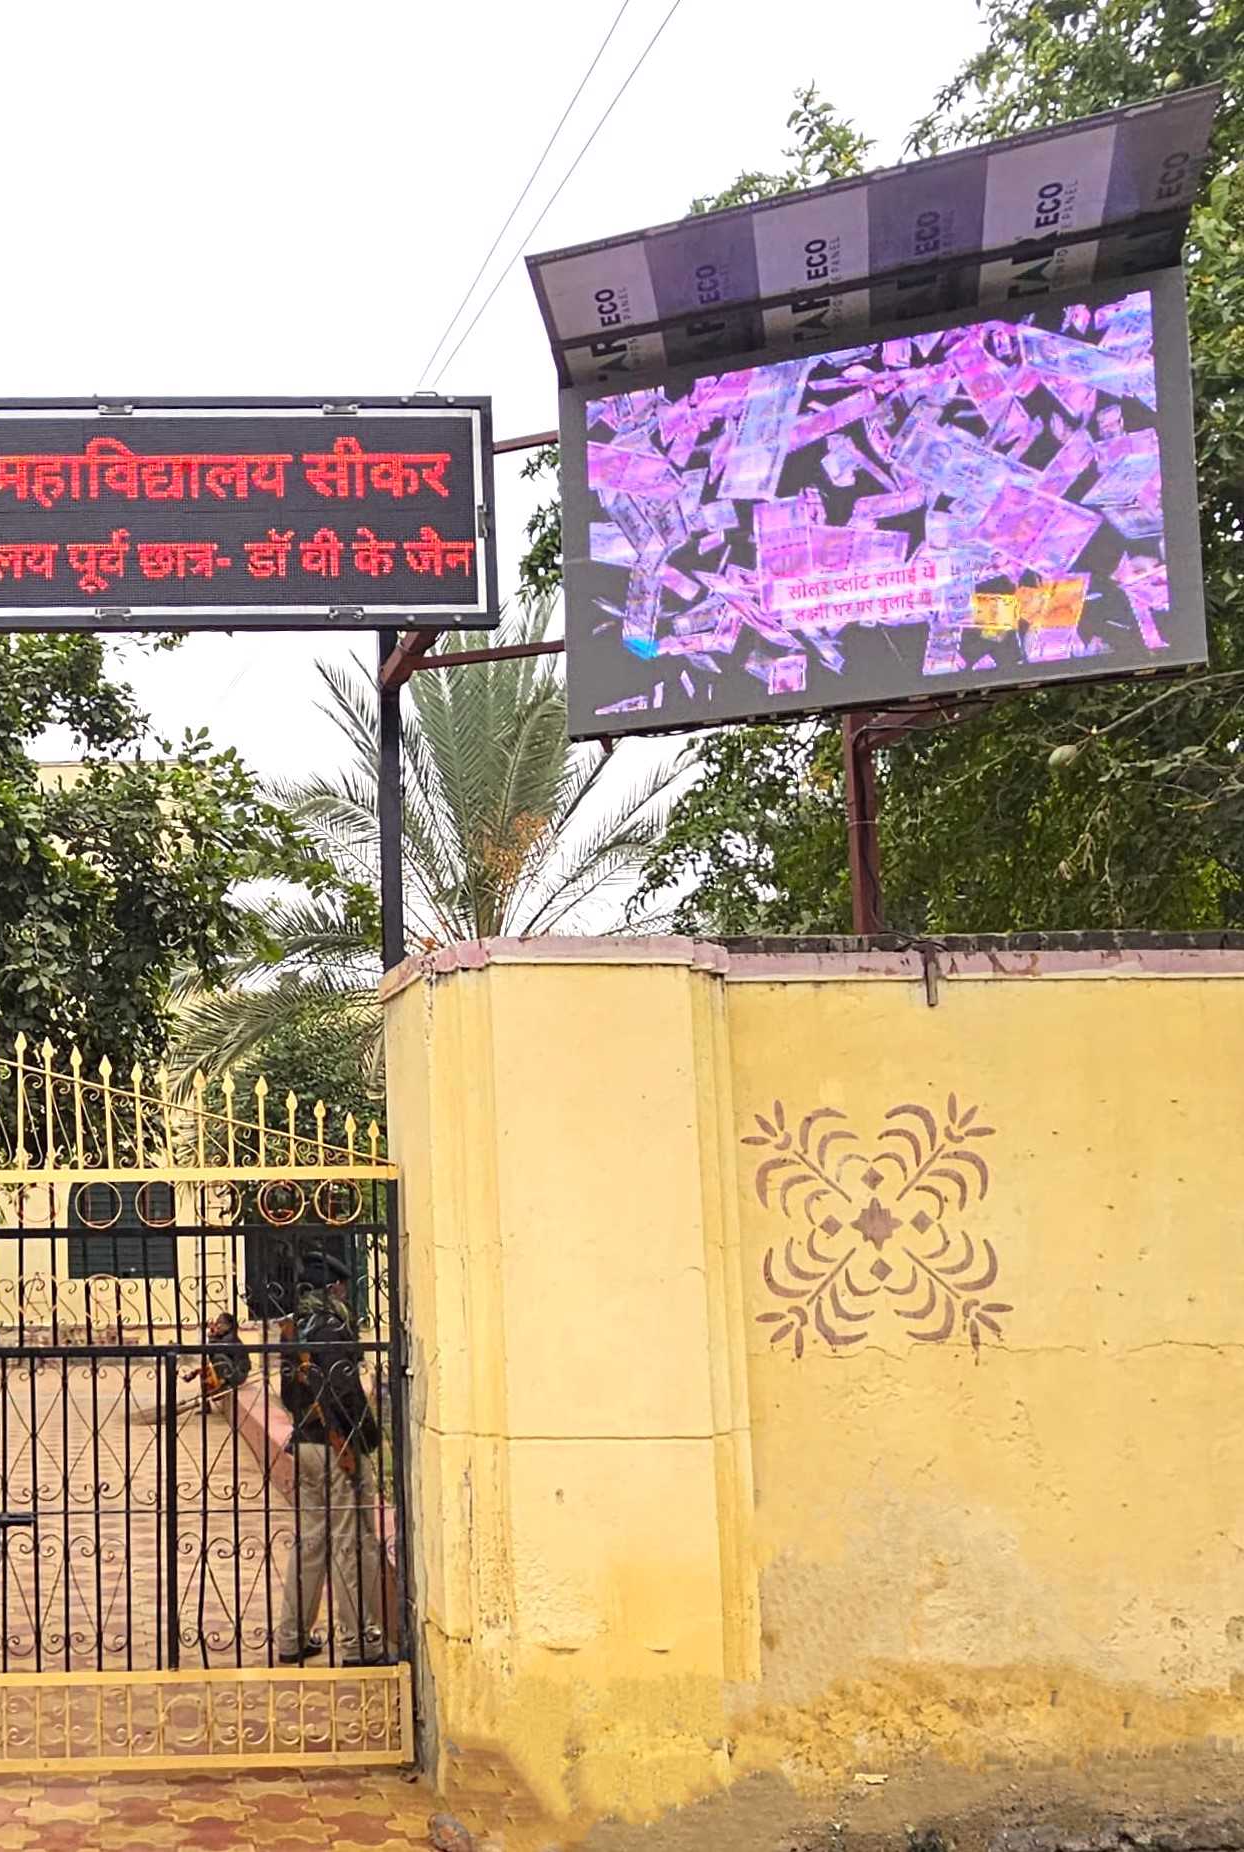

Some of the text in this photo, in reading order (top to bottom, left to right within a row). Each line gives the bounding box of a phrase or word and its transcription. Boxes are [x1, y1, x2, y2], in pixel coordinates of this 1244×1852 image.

[1035, 182, 1063, 229] ECO
[914, 211, 942, 256] ECO
[804, 239, 828, 281] ECO
[695, 265, 721, 304] ECO
[594, 288, 622, 327] ECO
[299, 436, 452, 499] सीकर
[67, 528, 129, 594] पूर्व
[244, 530, 293, 579] डॉ
[352, 528, 398, 576] के
[403, 526, 475, 576] जैन
